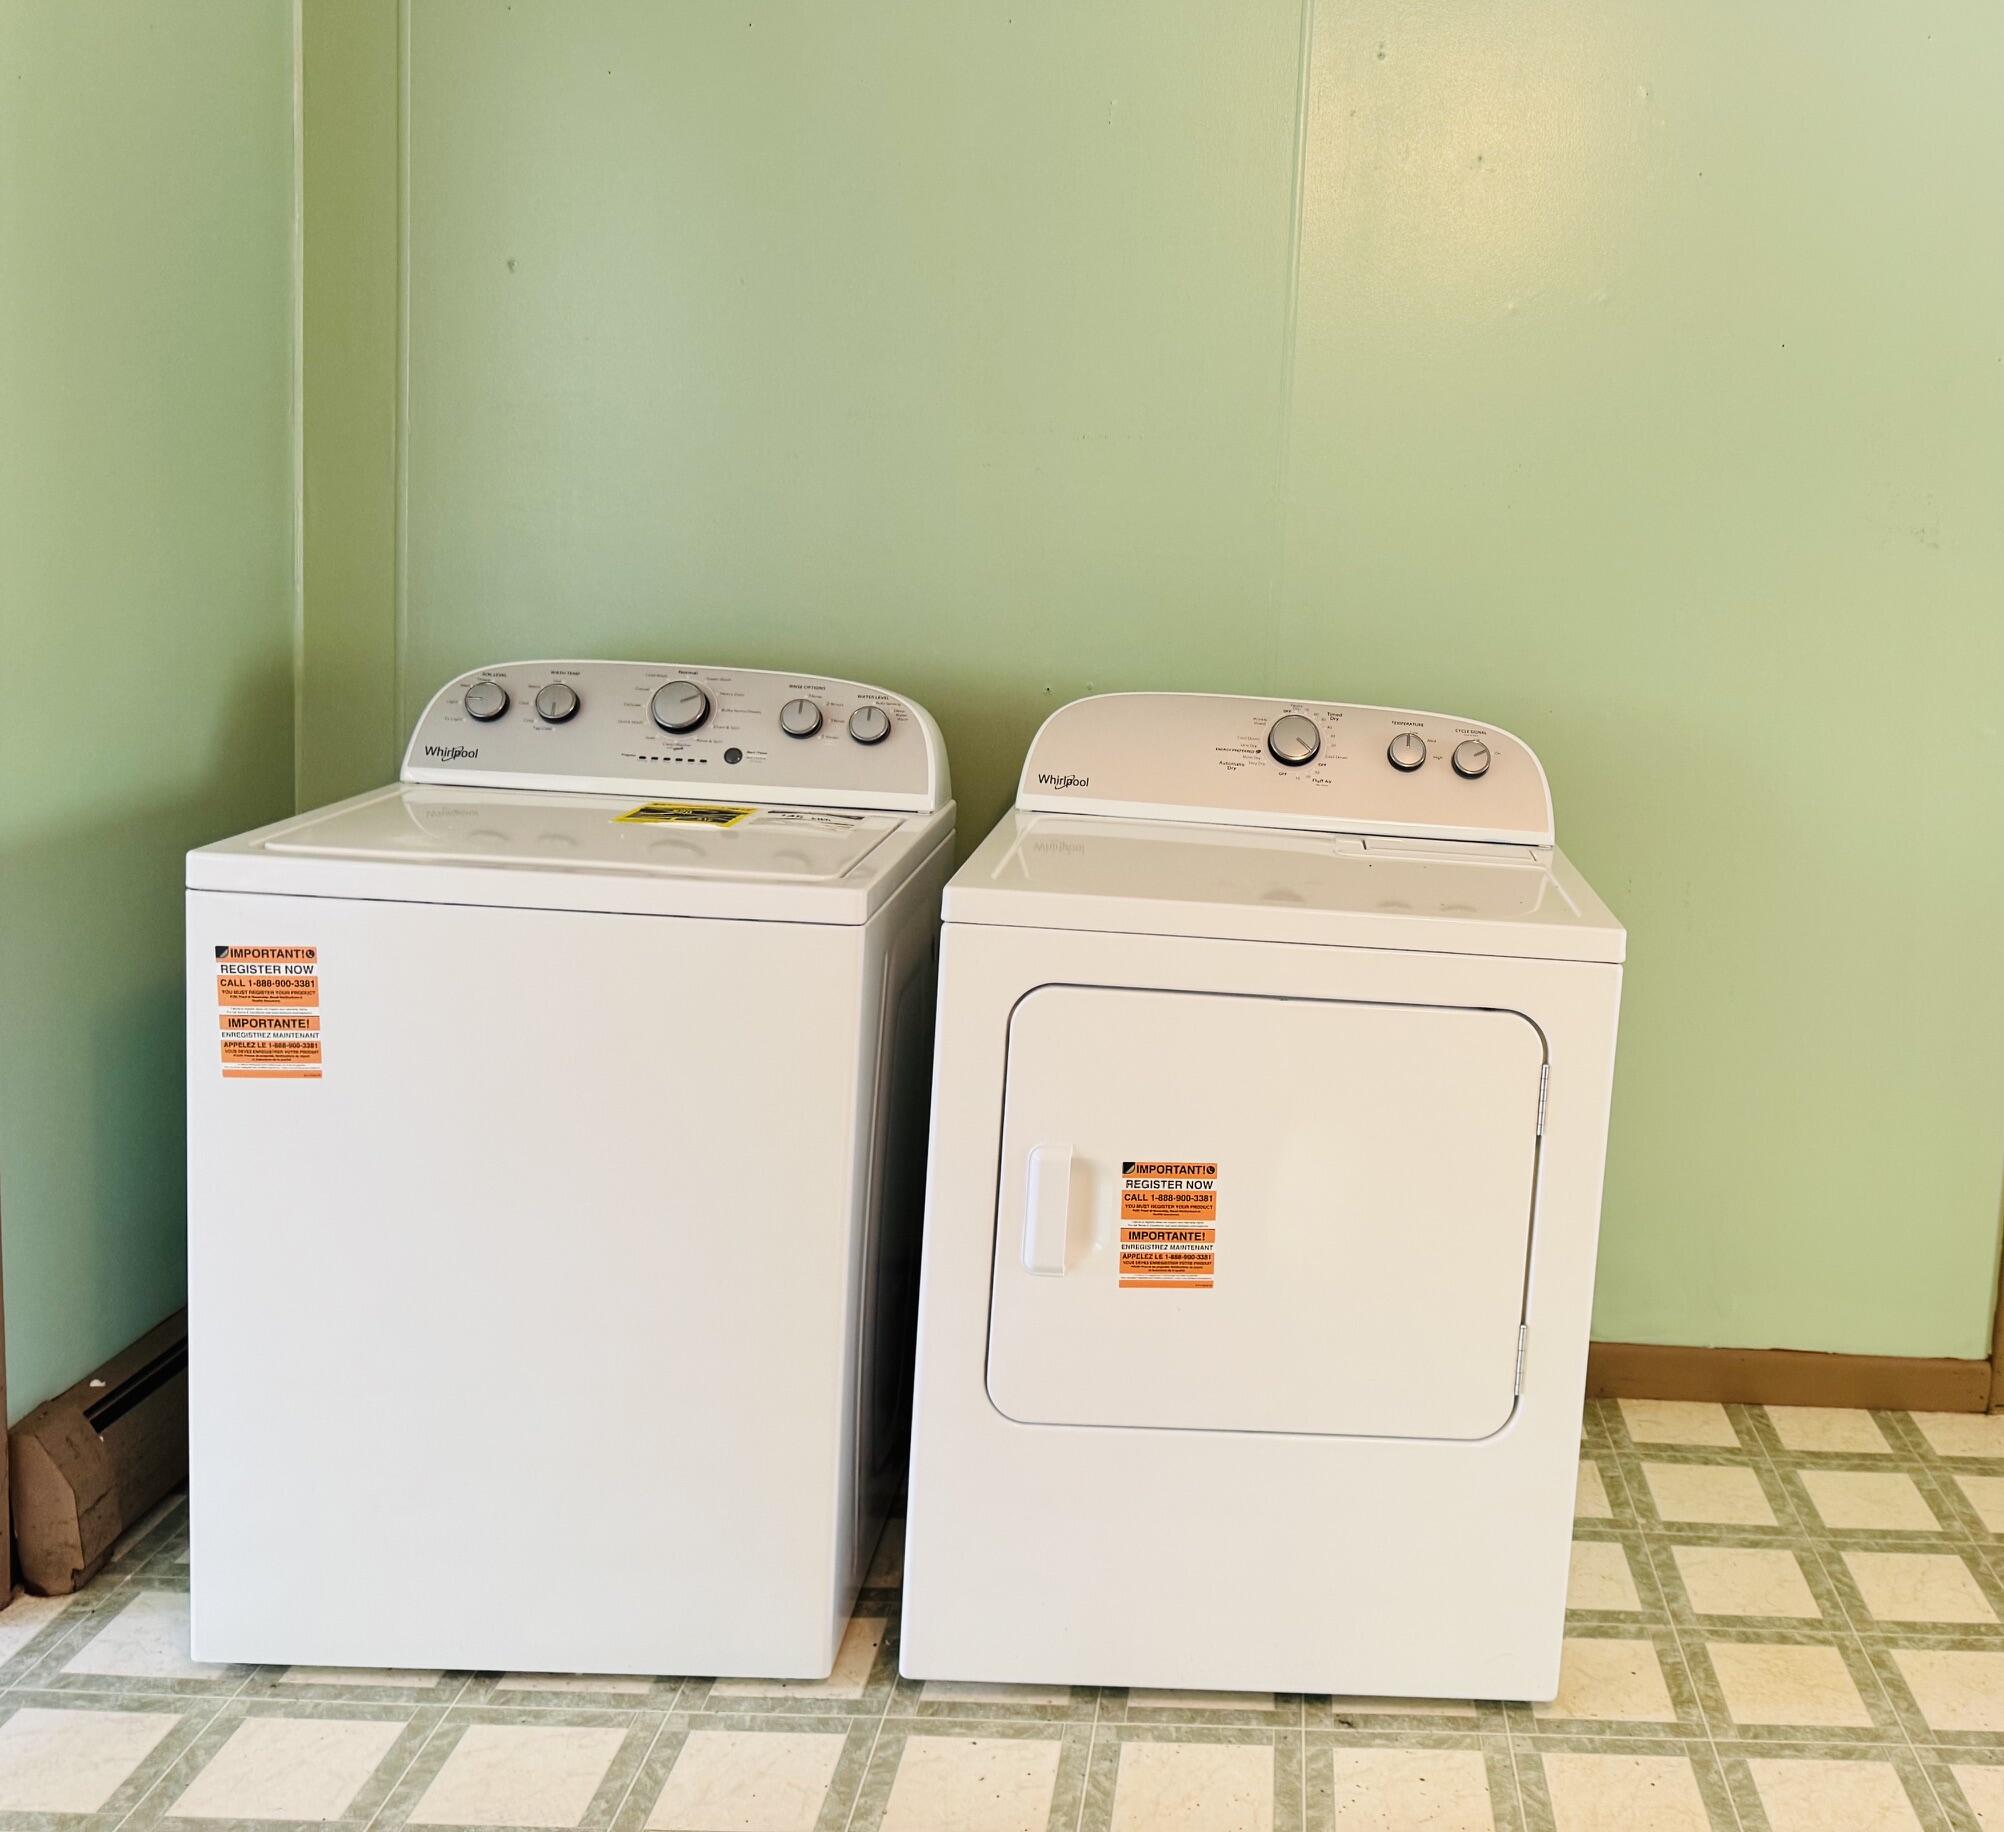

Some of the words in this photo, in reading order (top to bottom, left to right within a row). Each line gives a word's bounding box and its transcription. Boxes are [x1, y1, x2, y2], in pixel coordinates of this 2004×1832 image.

[424, 745, 478, 762] Whirlpool
[1038, 774, 1089, 789] Whirlpool
[230, 949, 304, 958] IMPORTANT!
[220, 964, 281, 974] REGISTER
[285, 965, 314, 974] NOW
[220, 979, 245, 987] CALL
[248, 980, 315, 988] 1-888-900-3381
[228, 1018, 309, 1028] IMPORTANTE!
[1136, 1165, 1206, 1174] IMPORTANT!
[1126, 1180, 1182, 1189] REGISTER
[1186, 1181, 1213, 1189] NOW
[1129, 1231, 1205, 1241] IMPORTANTE!
